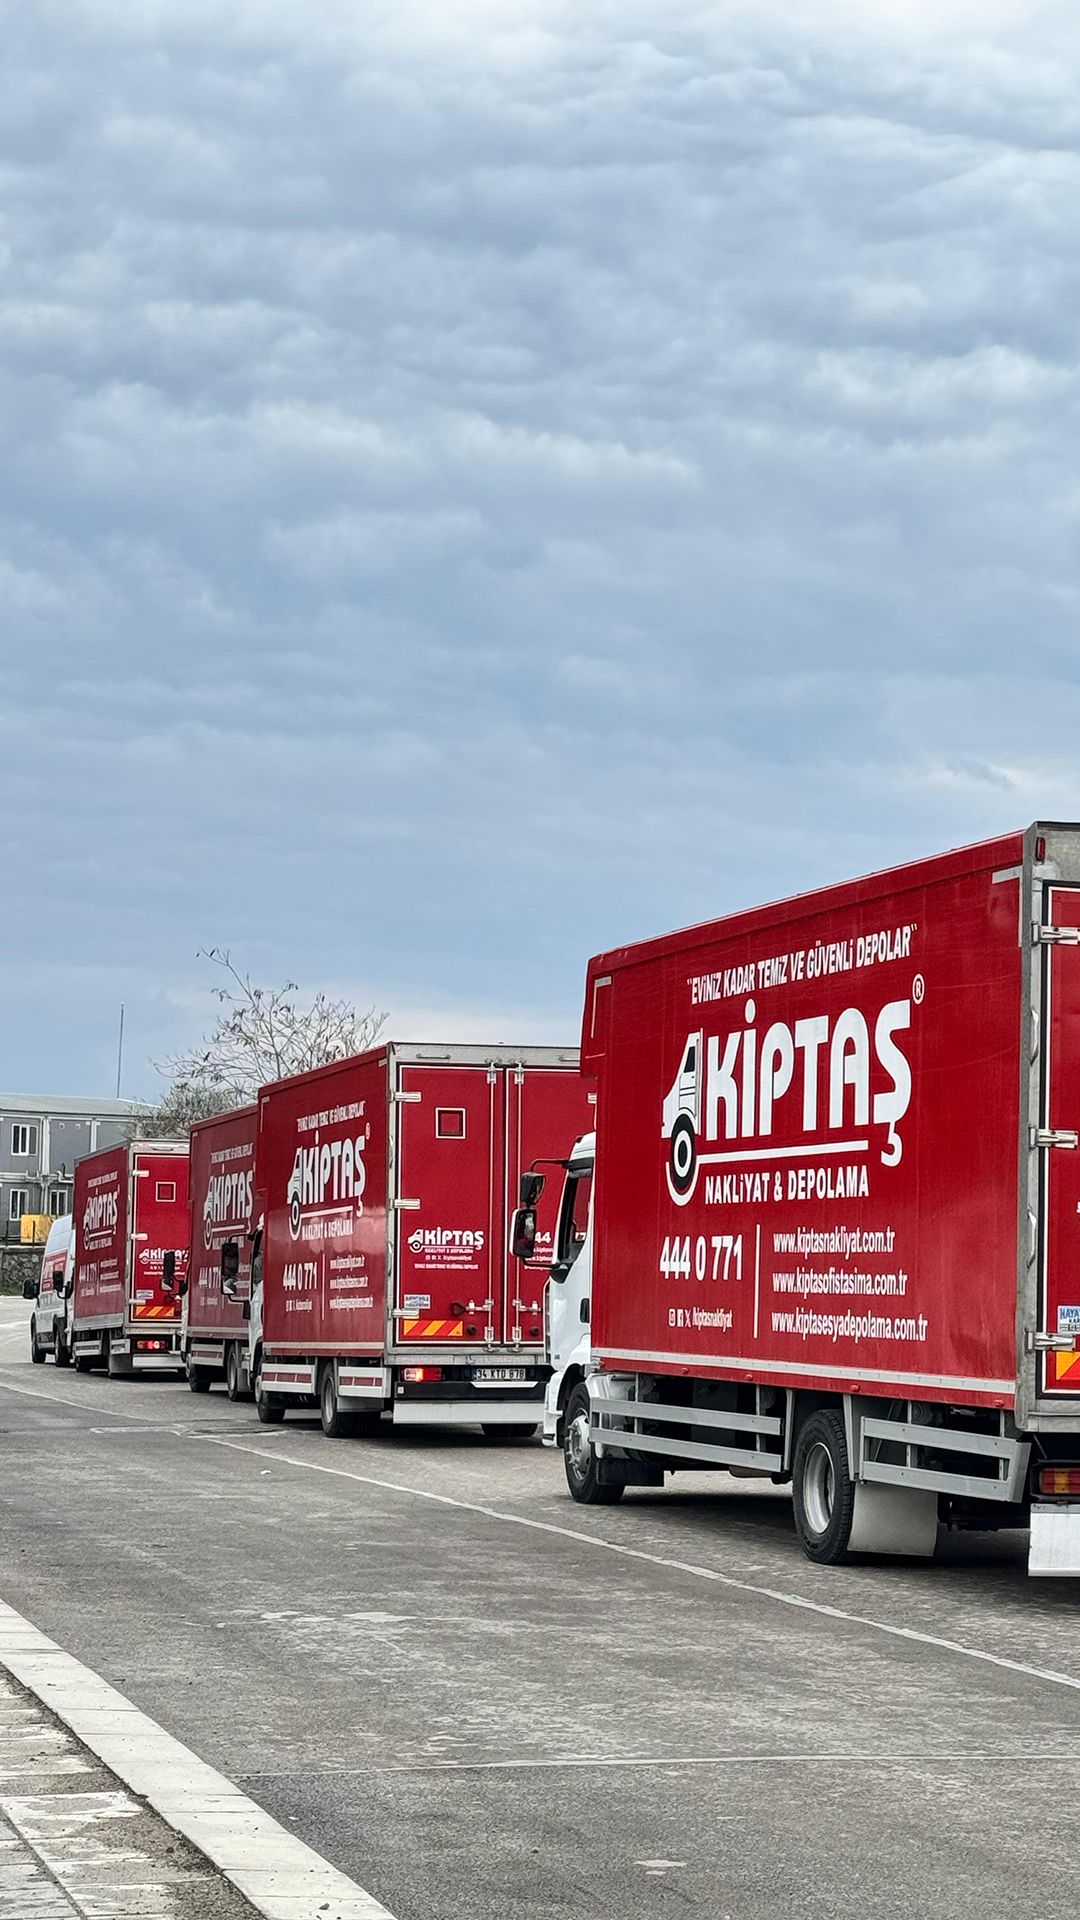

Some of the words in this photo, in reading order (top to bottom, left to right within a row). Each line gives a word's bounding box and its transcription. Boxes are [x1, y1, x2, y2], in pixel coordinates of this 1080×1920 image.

[723, 963, 755, 998] KADAR
[790, 950, 805, 981] VE
[705, 998, 912, 1167] KİPTAŞ
[302, 1130, 366, 1218] KİPTAŞ
[773, 1171, 783, 1202] &
[787, 1165, 869, 1200] DEPOLAMA
[424, 1226, 485, 1251] KİPTAŞ
[535, 1232, 551, 1243] 44
[773, 1225, 895, 1260] www.kiptasnakliyat.com.tr
[659, 1236, 691, 1280] 444
[695, 1235, 707, 1282] 0
[711, 1234, 743, 1280] 771
[304, 1262, 317, 1290] 771
[772, 1267, 908, 1299] www.kiptasofistasima.com.tr
[771, 1307, 928, 1343] www.kiptasesyadepolama.com.tr
[1059, 1307, 1080, 1319] HAYA
[477, 1369, 487, 1379] 34
